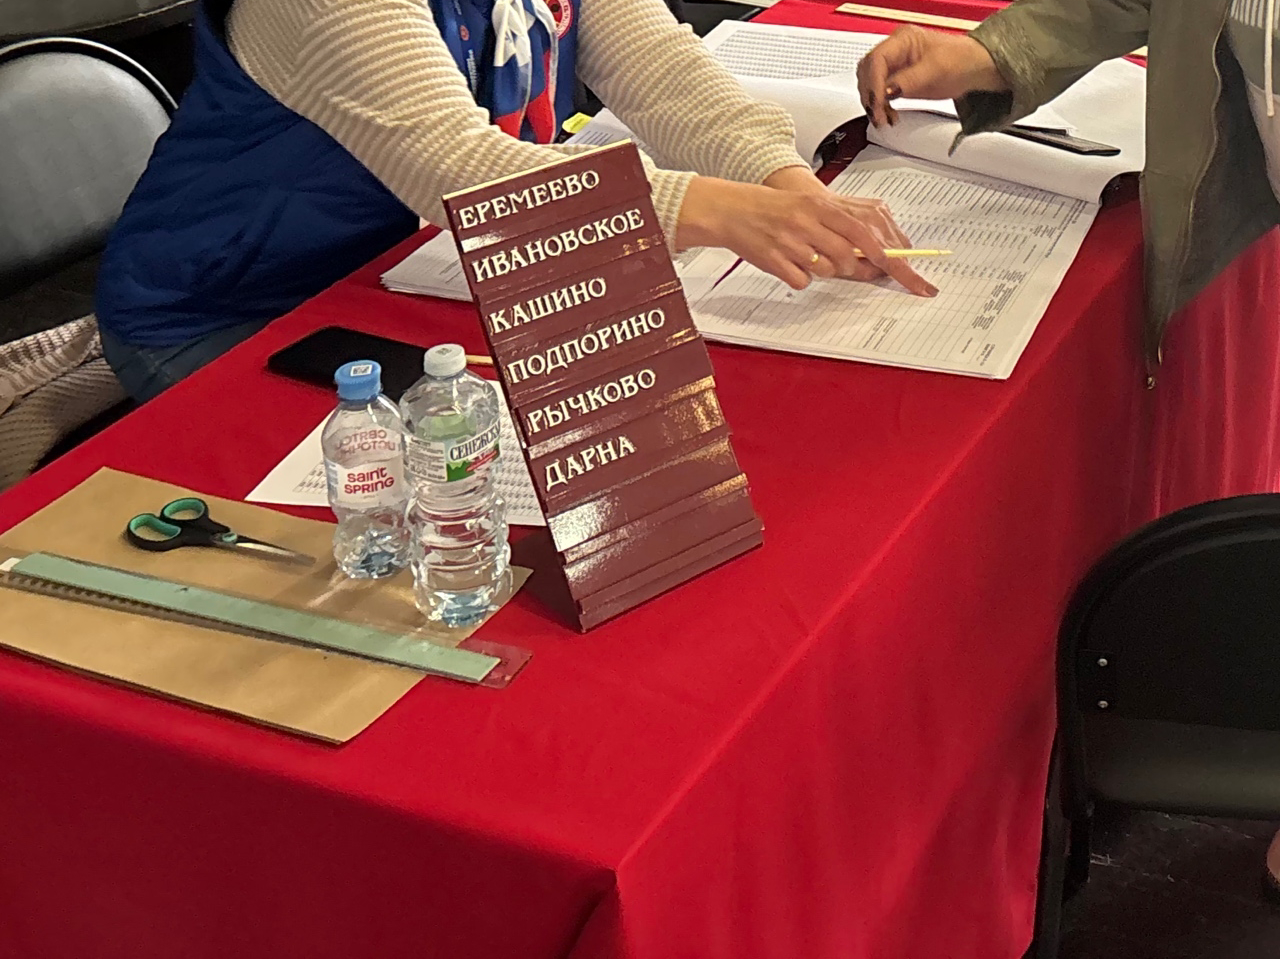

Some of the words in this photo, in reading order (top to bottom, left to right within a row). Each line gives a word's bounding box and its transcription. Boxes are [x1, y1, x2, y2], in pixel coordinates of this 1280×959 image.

[458, 170, 600, 229] ЕРЕМЕЕВО
[471, 208, 645, 283] ИВАНОВСКОЕ
[489, 277, 607, 334] КАШИНО
[506, 309, 666, 384] ПОДПОРИНО
[527, 368, 657, 434] РЫЧКОВО
[545, 436, 636, 492] ДАРНА
